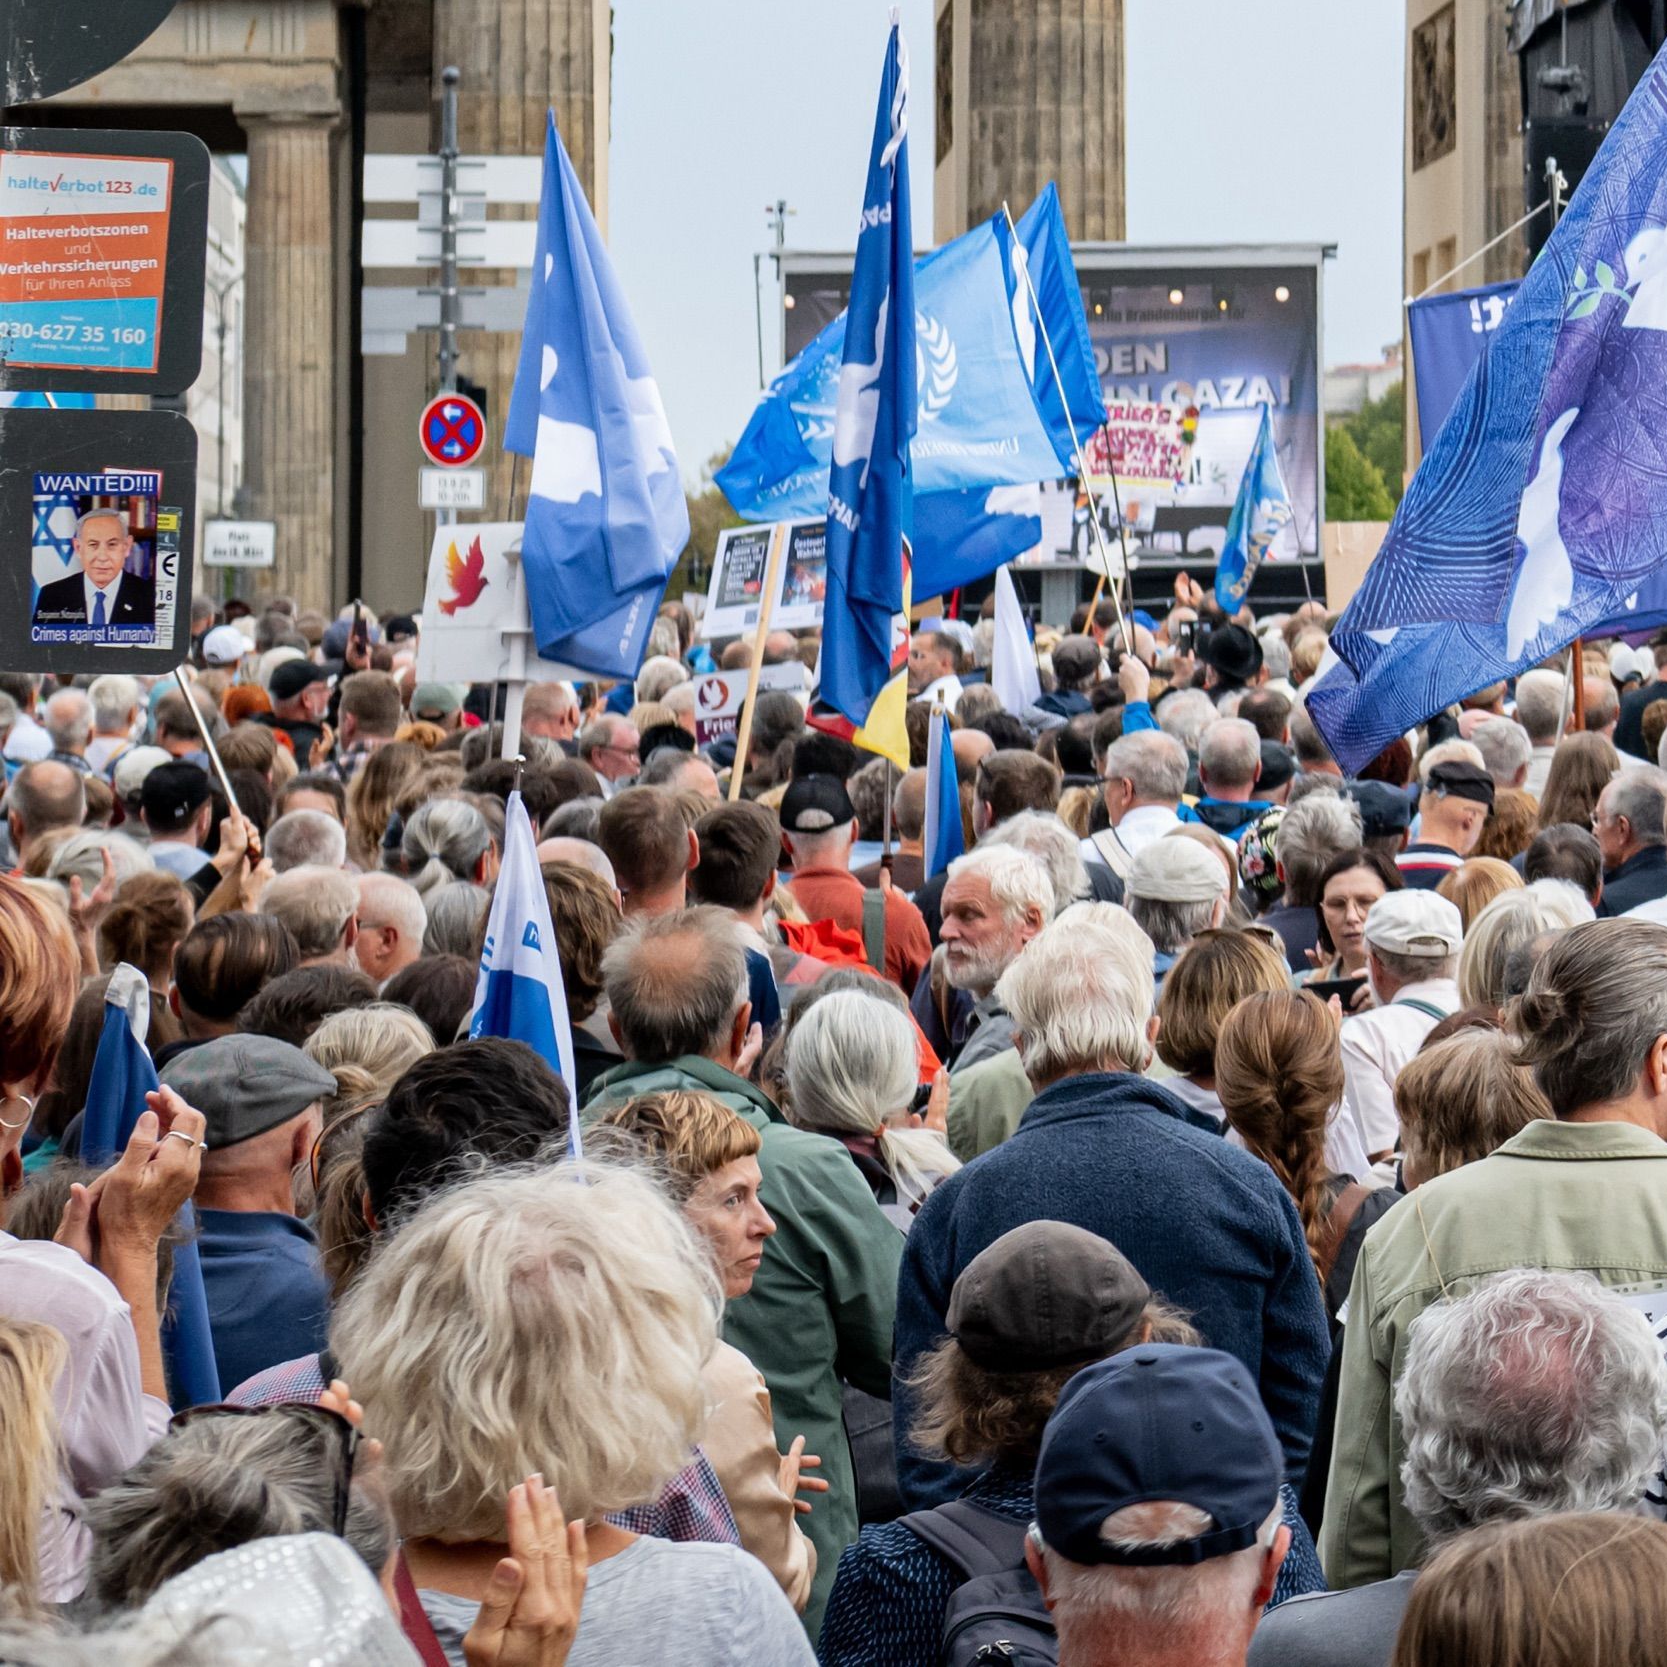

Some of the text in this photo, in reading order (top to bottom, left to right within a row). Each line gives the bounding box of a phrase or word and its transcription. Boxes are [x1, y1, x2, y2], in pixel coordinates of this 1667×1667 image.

[6, 223, 149, 241] Halteverbotszonen
[64, 243, 91, 256] und
[26, 274, 132, 292] für Ihren Anlass
[80, 324, 105, 343] 35
[111, 326, 147, 346] 160
[40, 475, 154, 492] WANTED!!!
[31, 625, 156, 645] Crimes against Humanity
